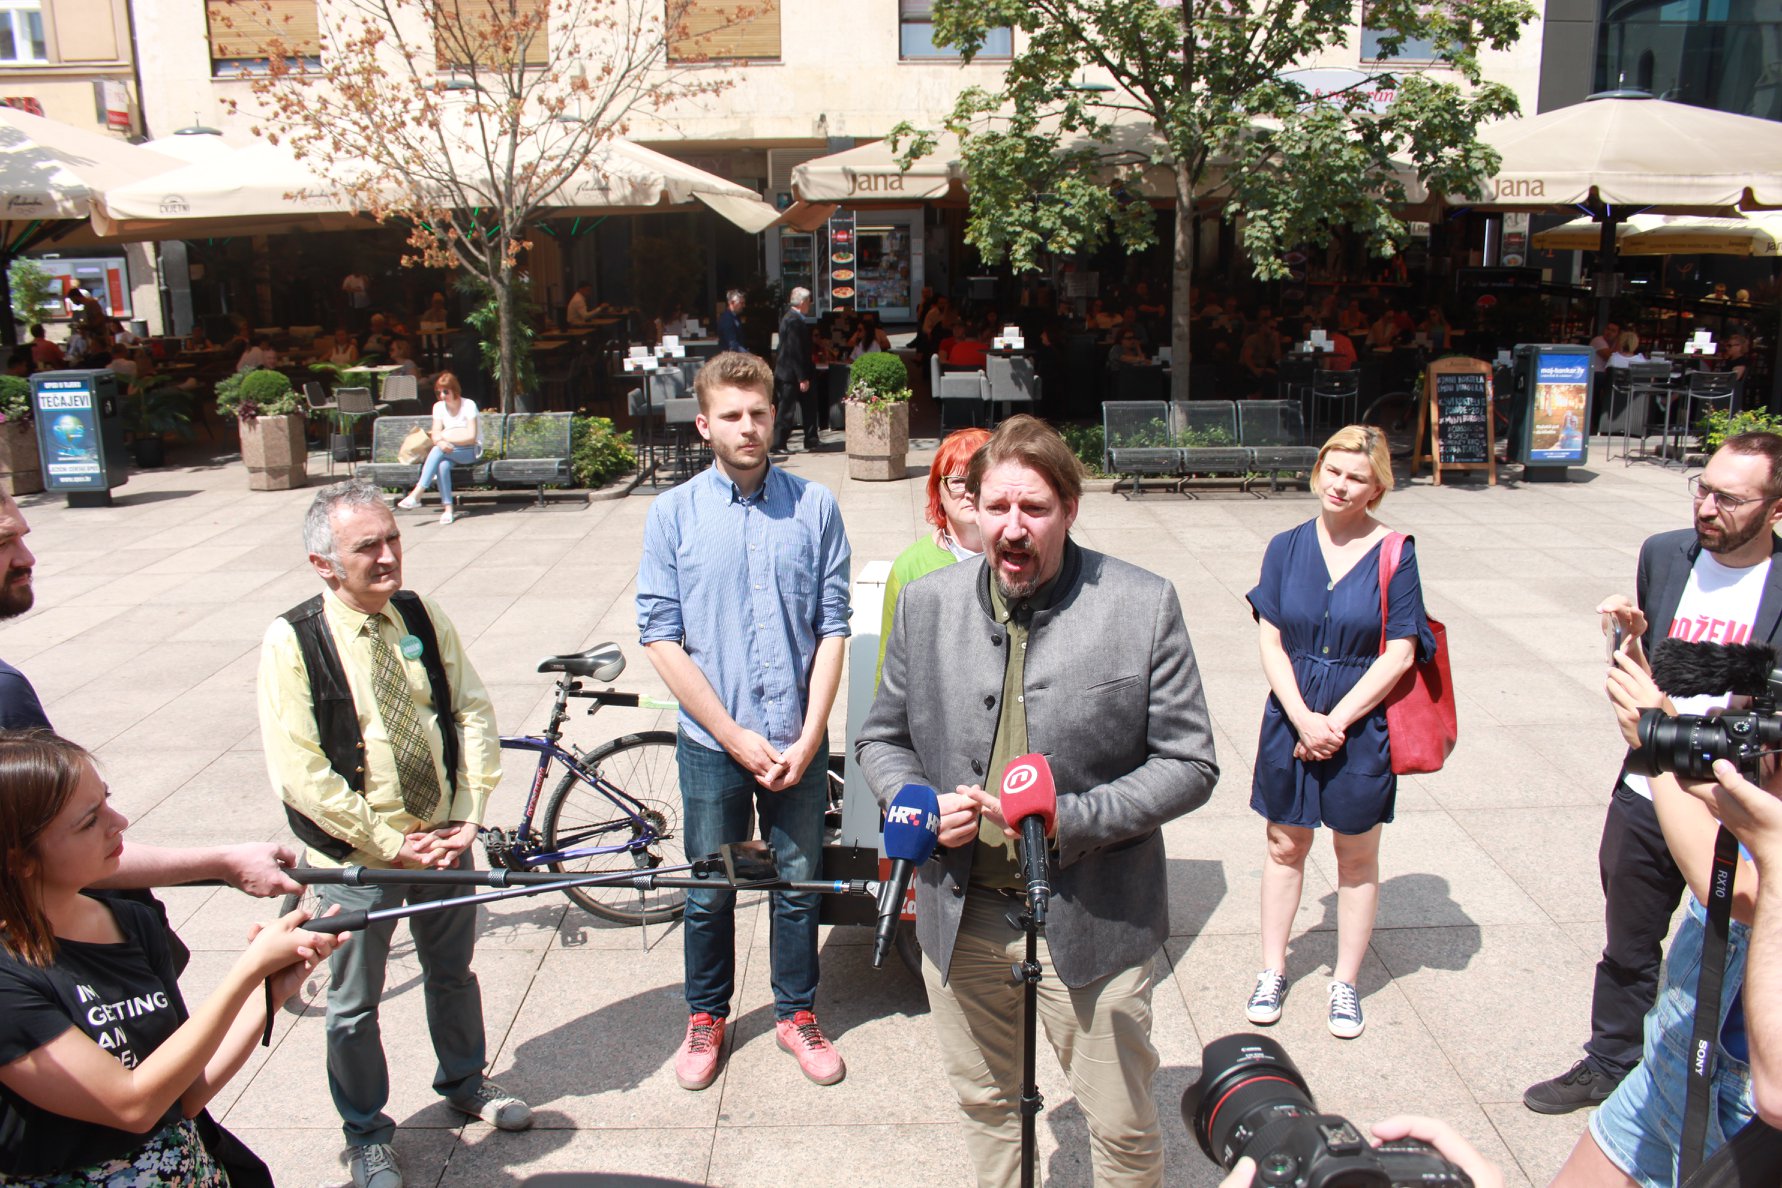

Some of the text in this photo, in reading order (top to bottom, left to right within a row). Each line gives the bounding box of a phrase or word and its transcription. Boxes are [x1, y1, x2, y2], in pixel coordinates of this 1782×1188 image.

[41, 393, 89, 408] TEČAJEVI
[1667, 614, 1754, 646] OŽEM
[887, 805, 922, 826] HRT
[926, 812, 941, 835] HR
[1715, 869, 1728, 898] RX10
[98, 1026, 127, 1049] AN
[1695, 1039, 1707, 1077] SONY
